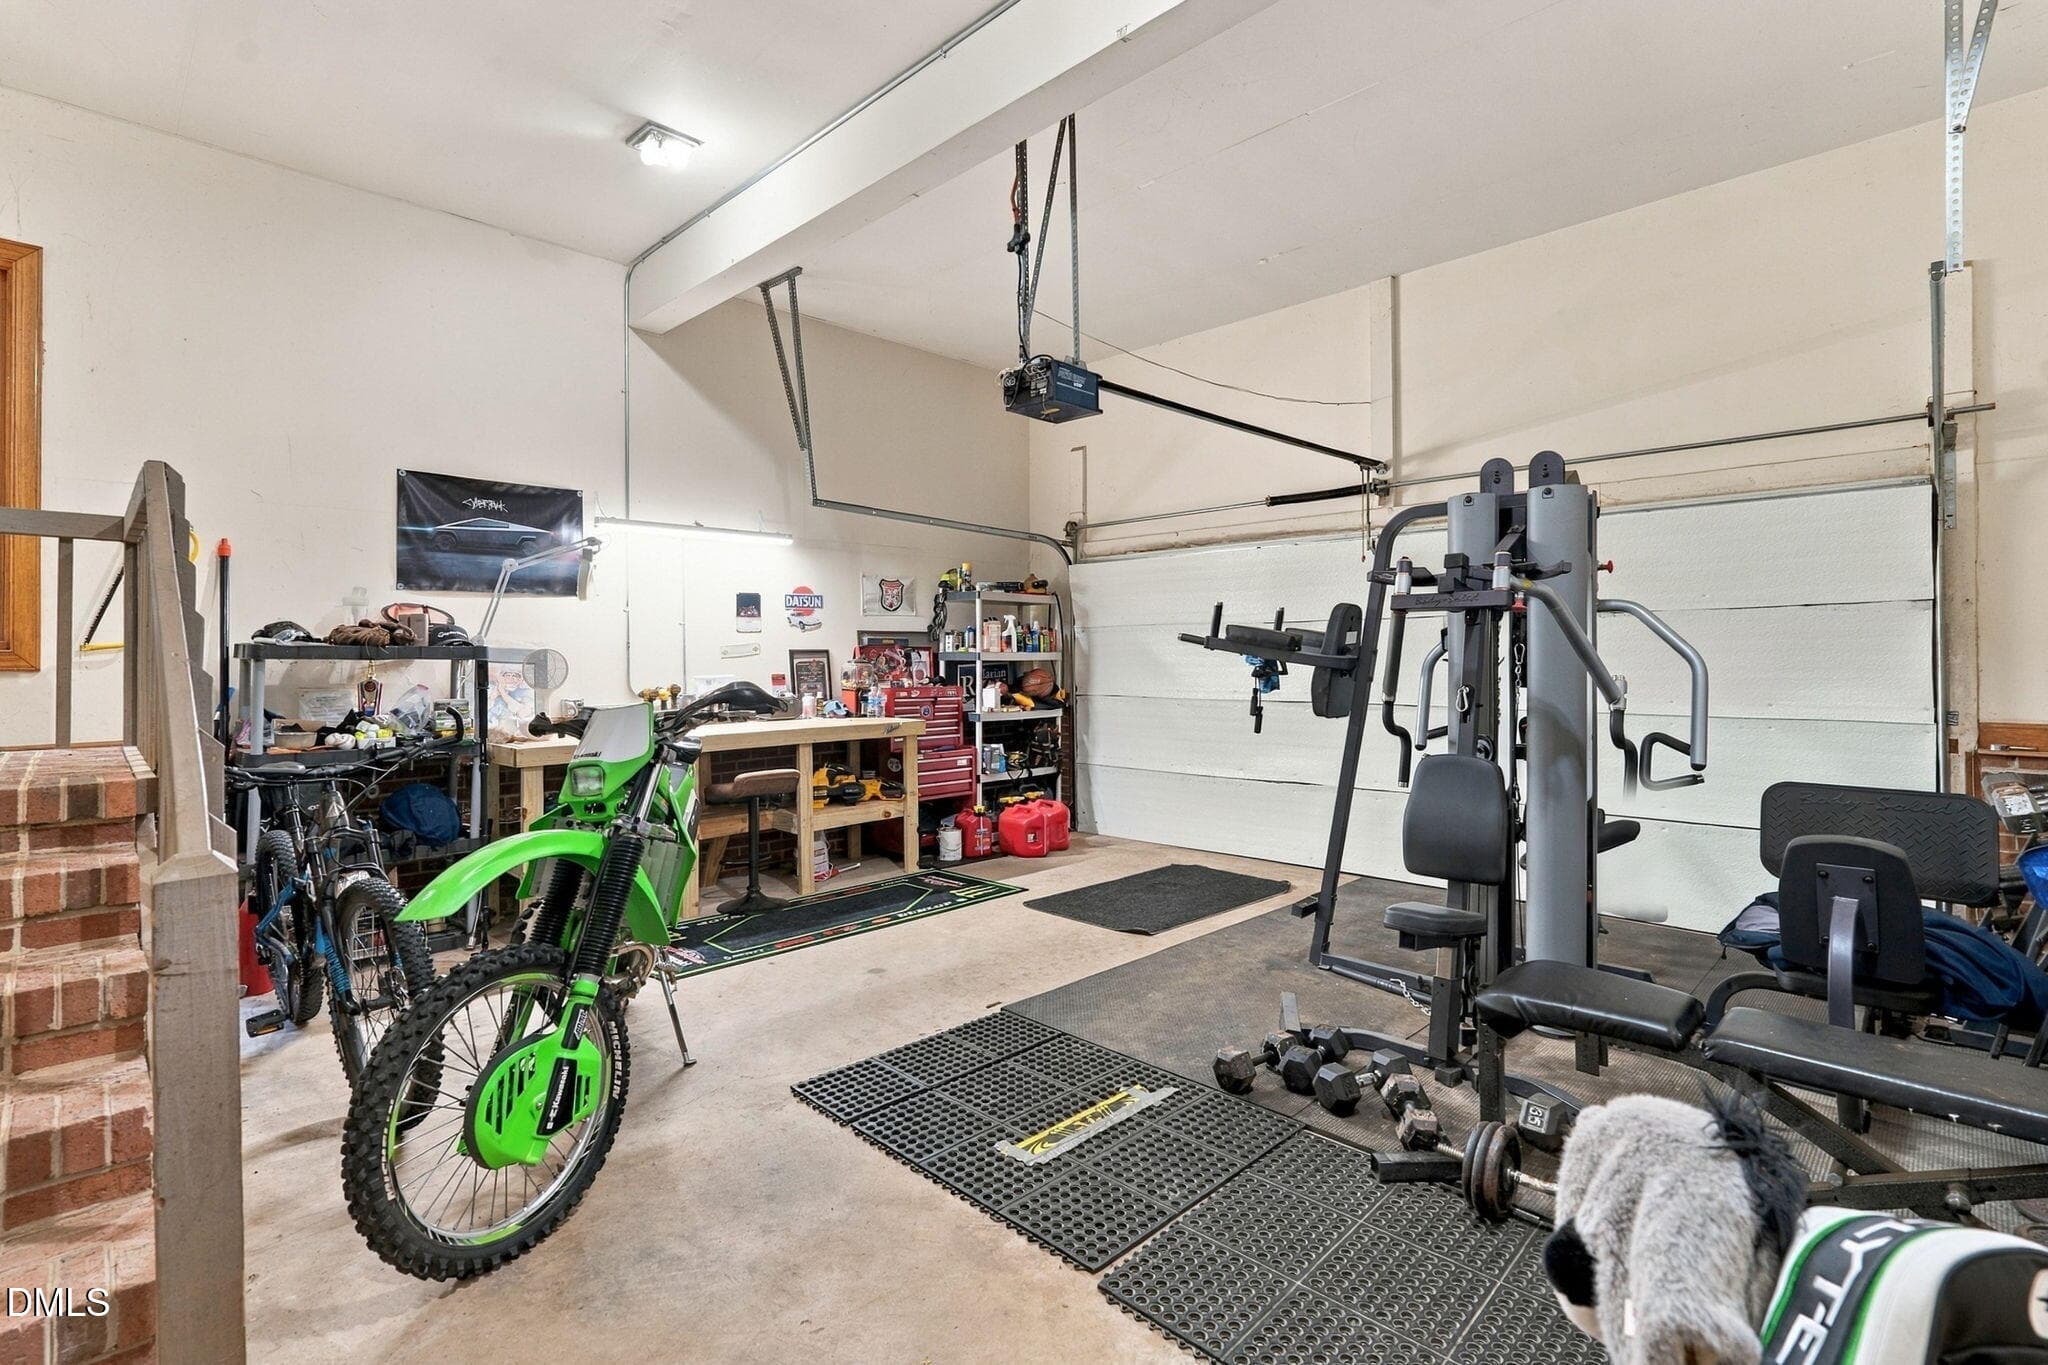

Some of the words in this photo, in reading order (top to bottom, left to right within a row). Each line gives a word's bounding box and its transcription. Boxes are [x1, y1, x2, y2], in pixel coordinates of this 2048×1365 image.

[785, 595, 822, 607] DATSUN
[608, 1021, 622, 1100] MICHELIN
[1528, 1106, 1543, 1126] 35
